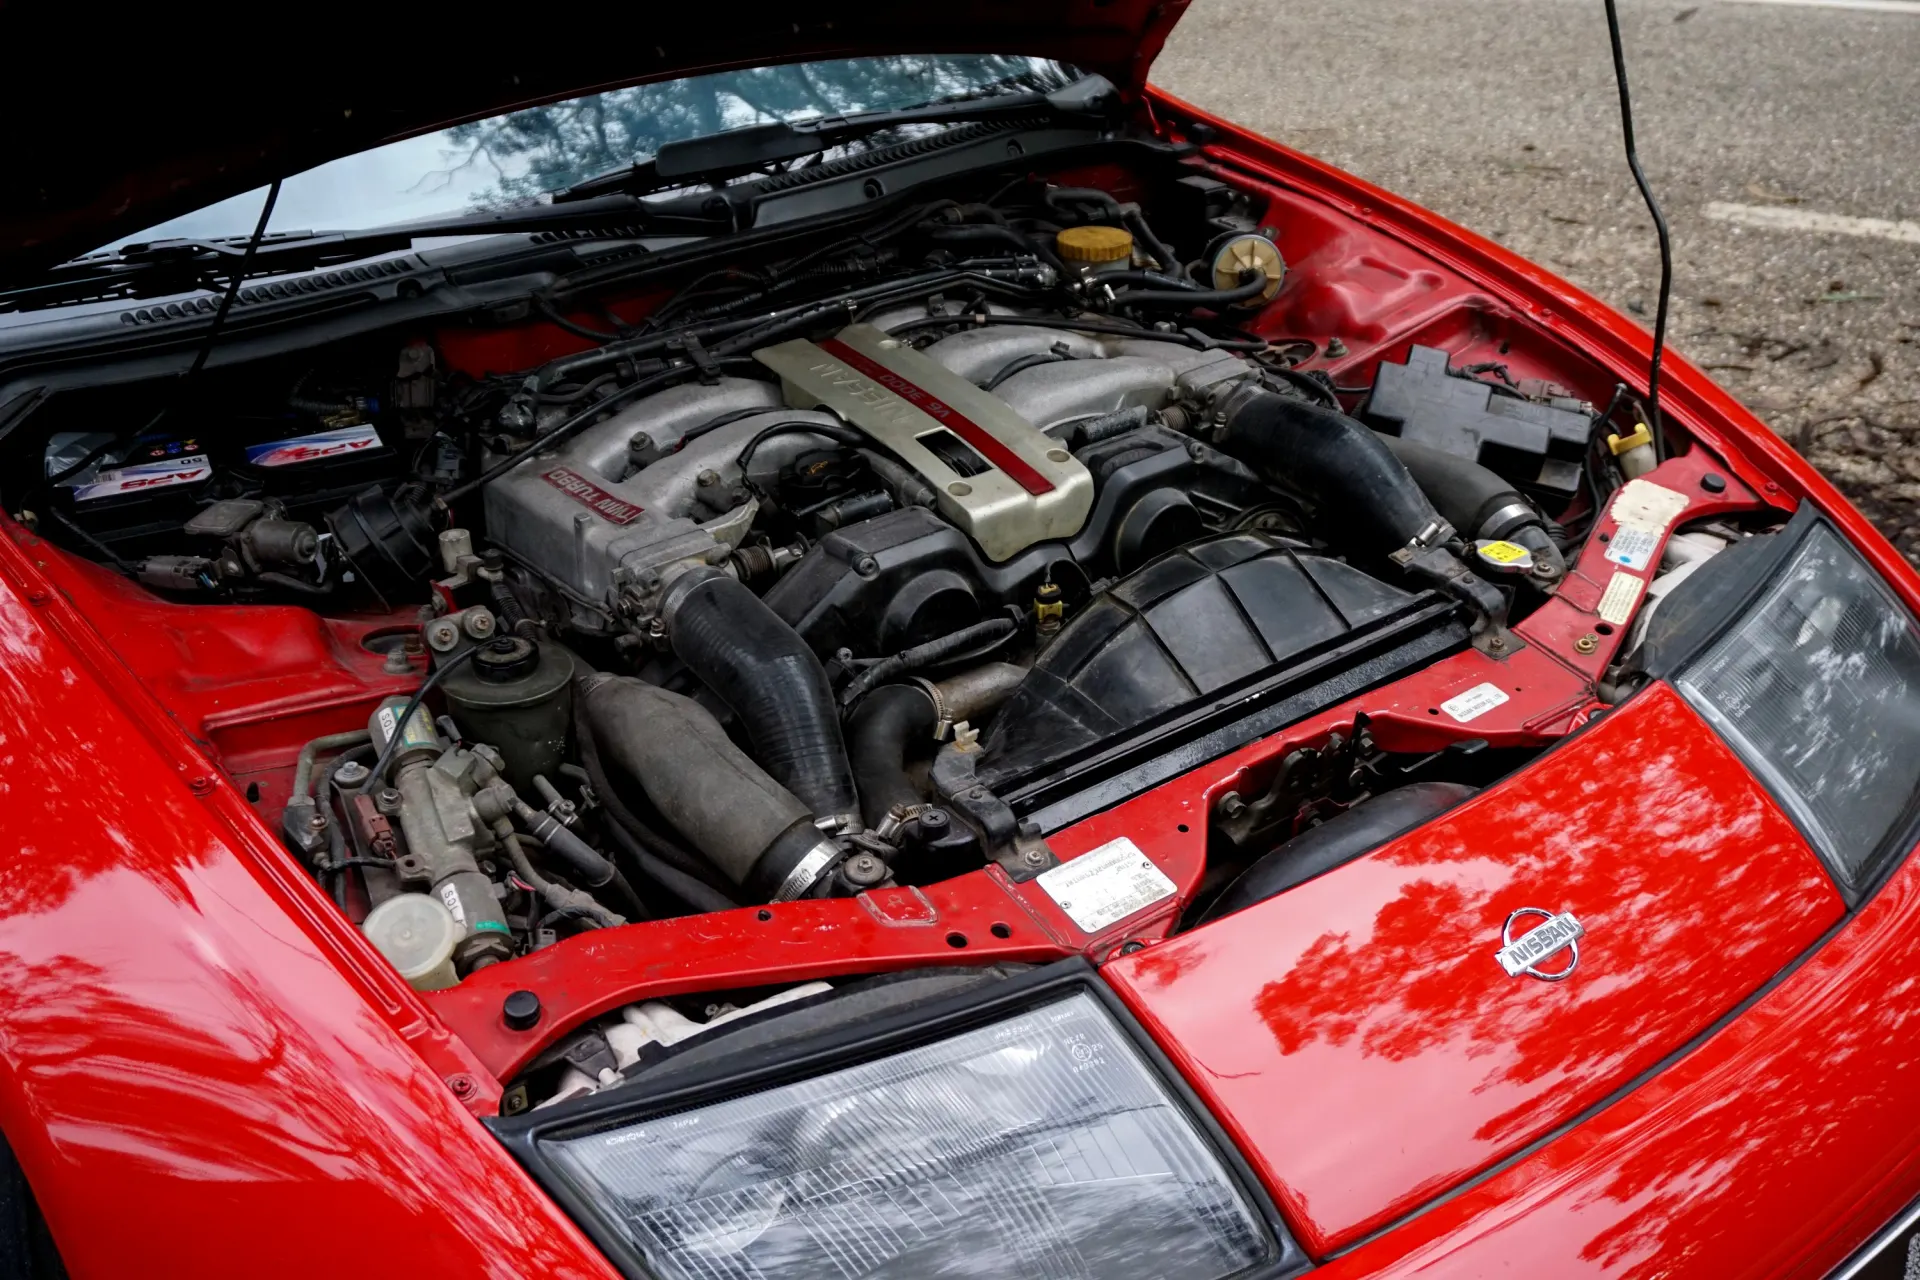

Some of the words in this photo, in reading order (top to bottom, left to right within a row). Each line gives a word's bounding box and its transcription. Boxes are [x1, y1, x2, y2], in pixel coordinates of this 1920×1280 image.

[809, 363, 914, 423] NISSAN
[878, 373, 928, 401] 3000
[928, 401, 951, 418] V6
[547, 469, 601, 502] TURBO
[594, 498, 637, 520] TWIN
[1508, 917, 1577, 966] NISSAN
